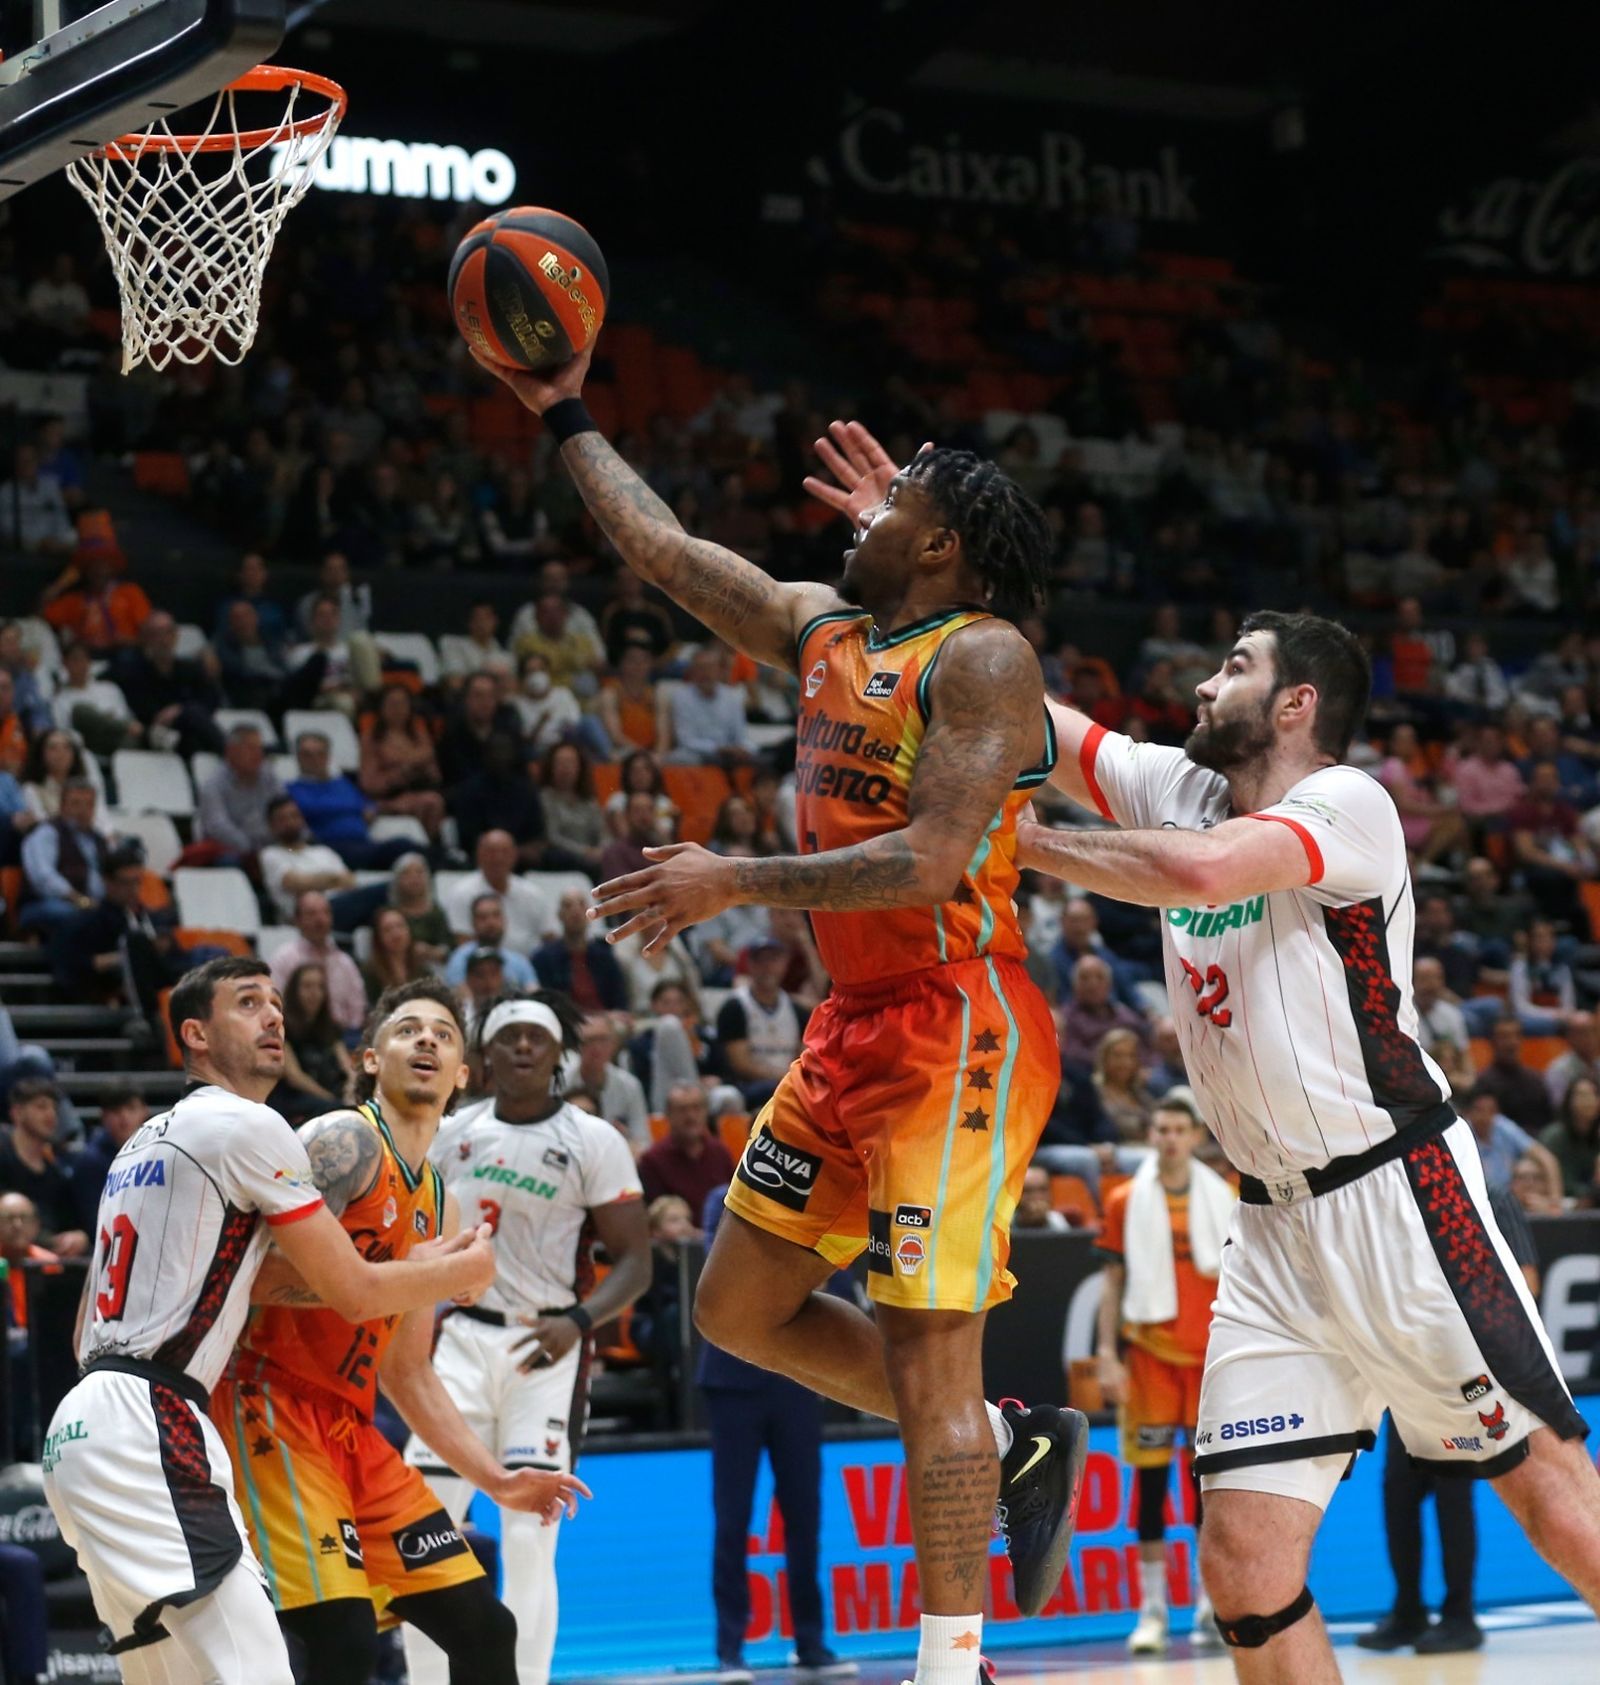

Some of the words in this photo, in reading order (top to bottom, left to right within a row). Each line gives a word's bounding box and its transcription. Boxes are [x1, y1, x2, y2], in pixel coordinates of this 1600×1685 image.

[269, 135, 517, 206] zummo
[797, 707, 867, 755] ultura
[863, 739, 902, 764] del
[754, 1135, 812, 1179] ULEVA
[898, 1214, 924, 1226] acb
[868, 1235, 892, 1258] dea
[1465, 1384, 1487, 1401] acb
[1220, 1415, 1286, 1441] asisa
[413, 1529, 462, 1555] Mide
